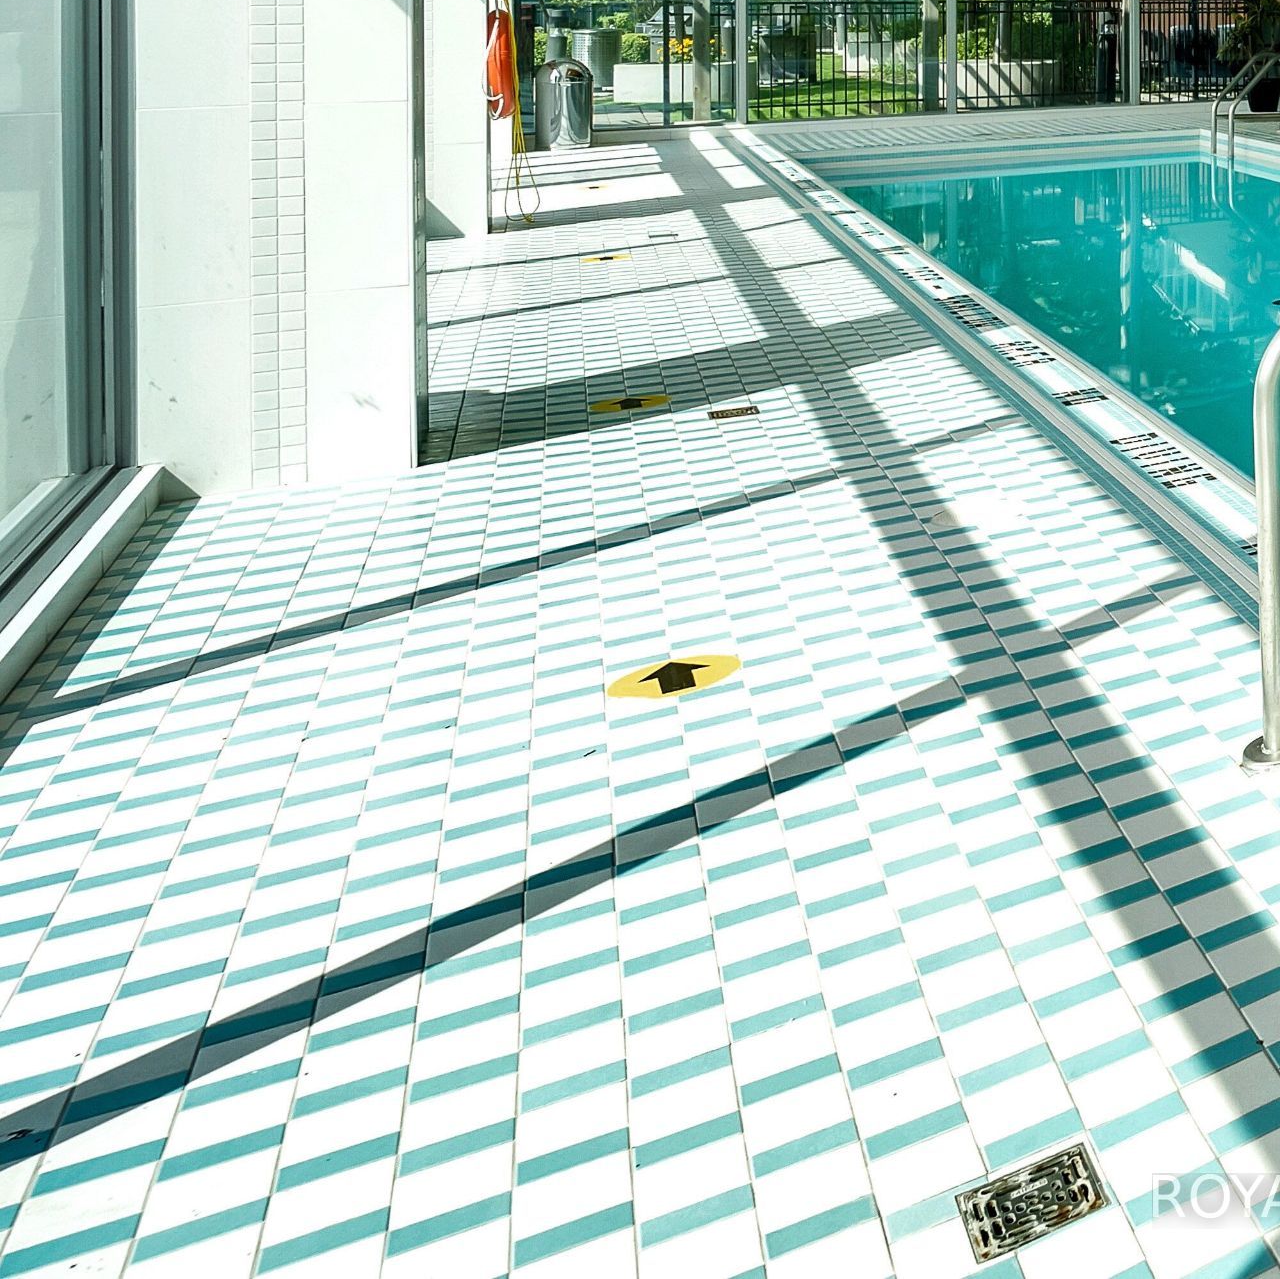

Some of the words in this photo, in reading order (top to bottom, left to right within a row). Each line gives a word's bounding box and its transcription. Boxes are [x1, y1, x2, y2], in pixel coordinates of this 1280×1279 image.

[990, 340, 1057, 368] AREA
[1051, 387, 1109, 407] NO
[1109, 432, 1217, 489] DIVING
